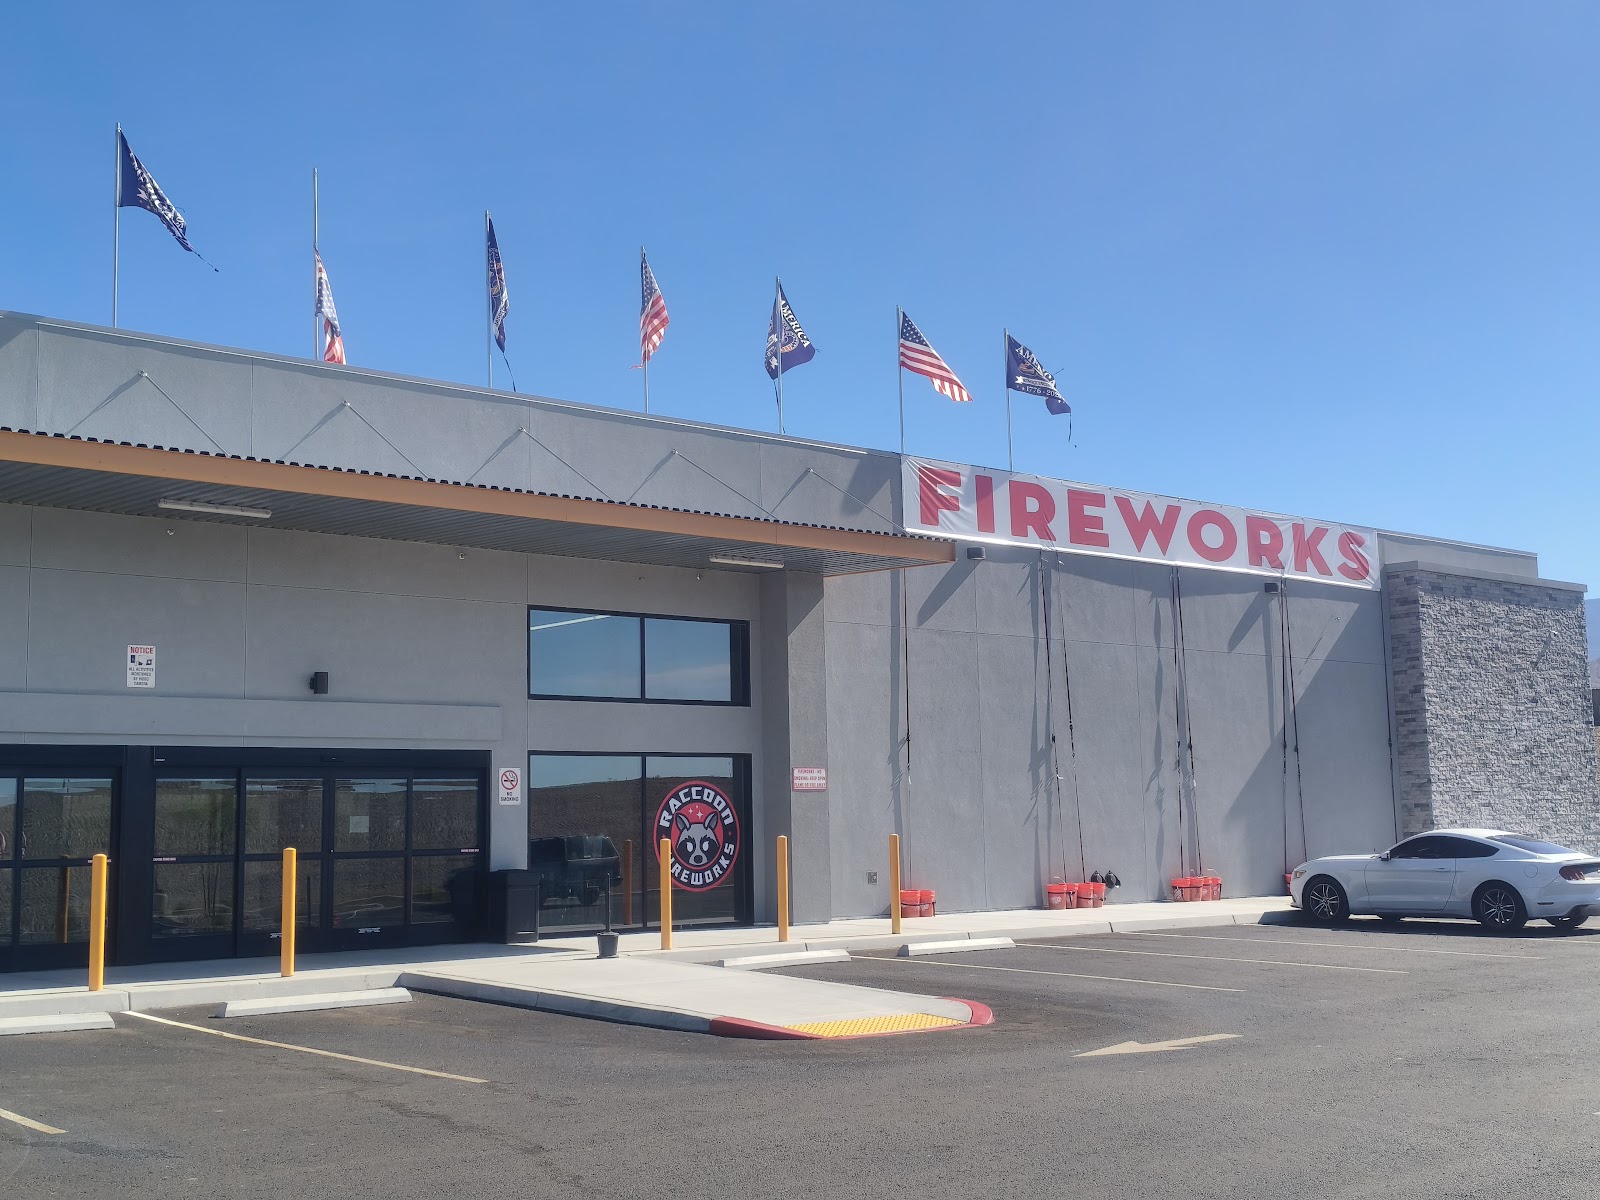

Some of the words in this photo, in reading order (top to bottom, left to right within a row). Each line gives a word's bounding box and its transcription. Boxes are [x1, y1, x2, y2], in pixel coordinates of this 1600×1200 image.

[1026, 385, 1042, 394] 1776
[1046, 389, 1062, 399] 202
[919, 466, 1371, 581] FIREWORKS
[130, 646, 154, 654] NOTICE
[660, 786, 734, 828] RACCOON
[671, 842, 735, 885] REWORKS
